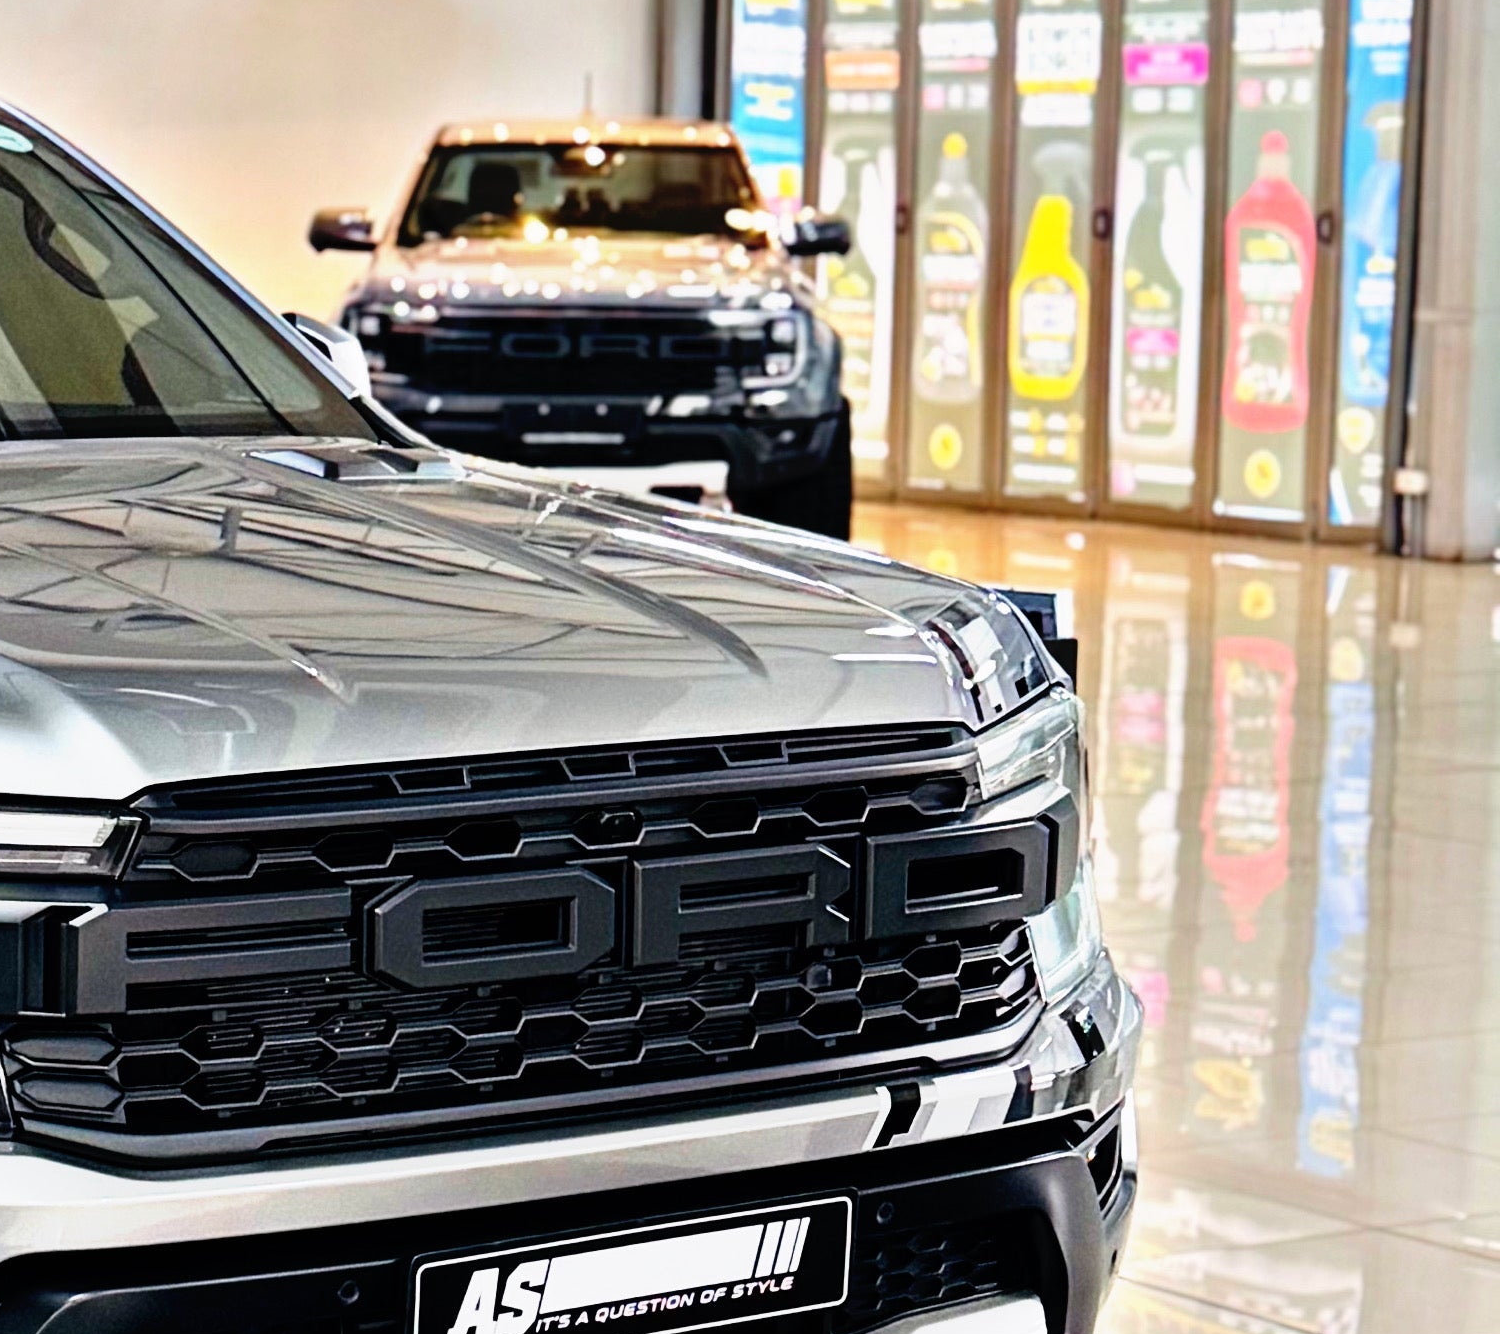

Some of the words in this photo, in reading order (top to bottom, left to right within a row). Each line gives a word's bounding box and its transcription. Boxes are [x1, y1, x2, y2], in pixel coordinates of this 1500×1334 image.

[425, 331, 730, 360] FORD
[67, 815, 1062, 1017] FORD
[536, 1312, 571, 1333] IT'S
[575, 1310, 589, 1327] A
[594, 1292, 695, 1324] QUESTION
[700, 1285, 727, 1305] OF
[731, 1275, 795, 1300] STYLE
